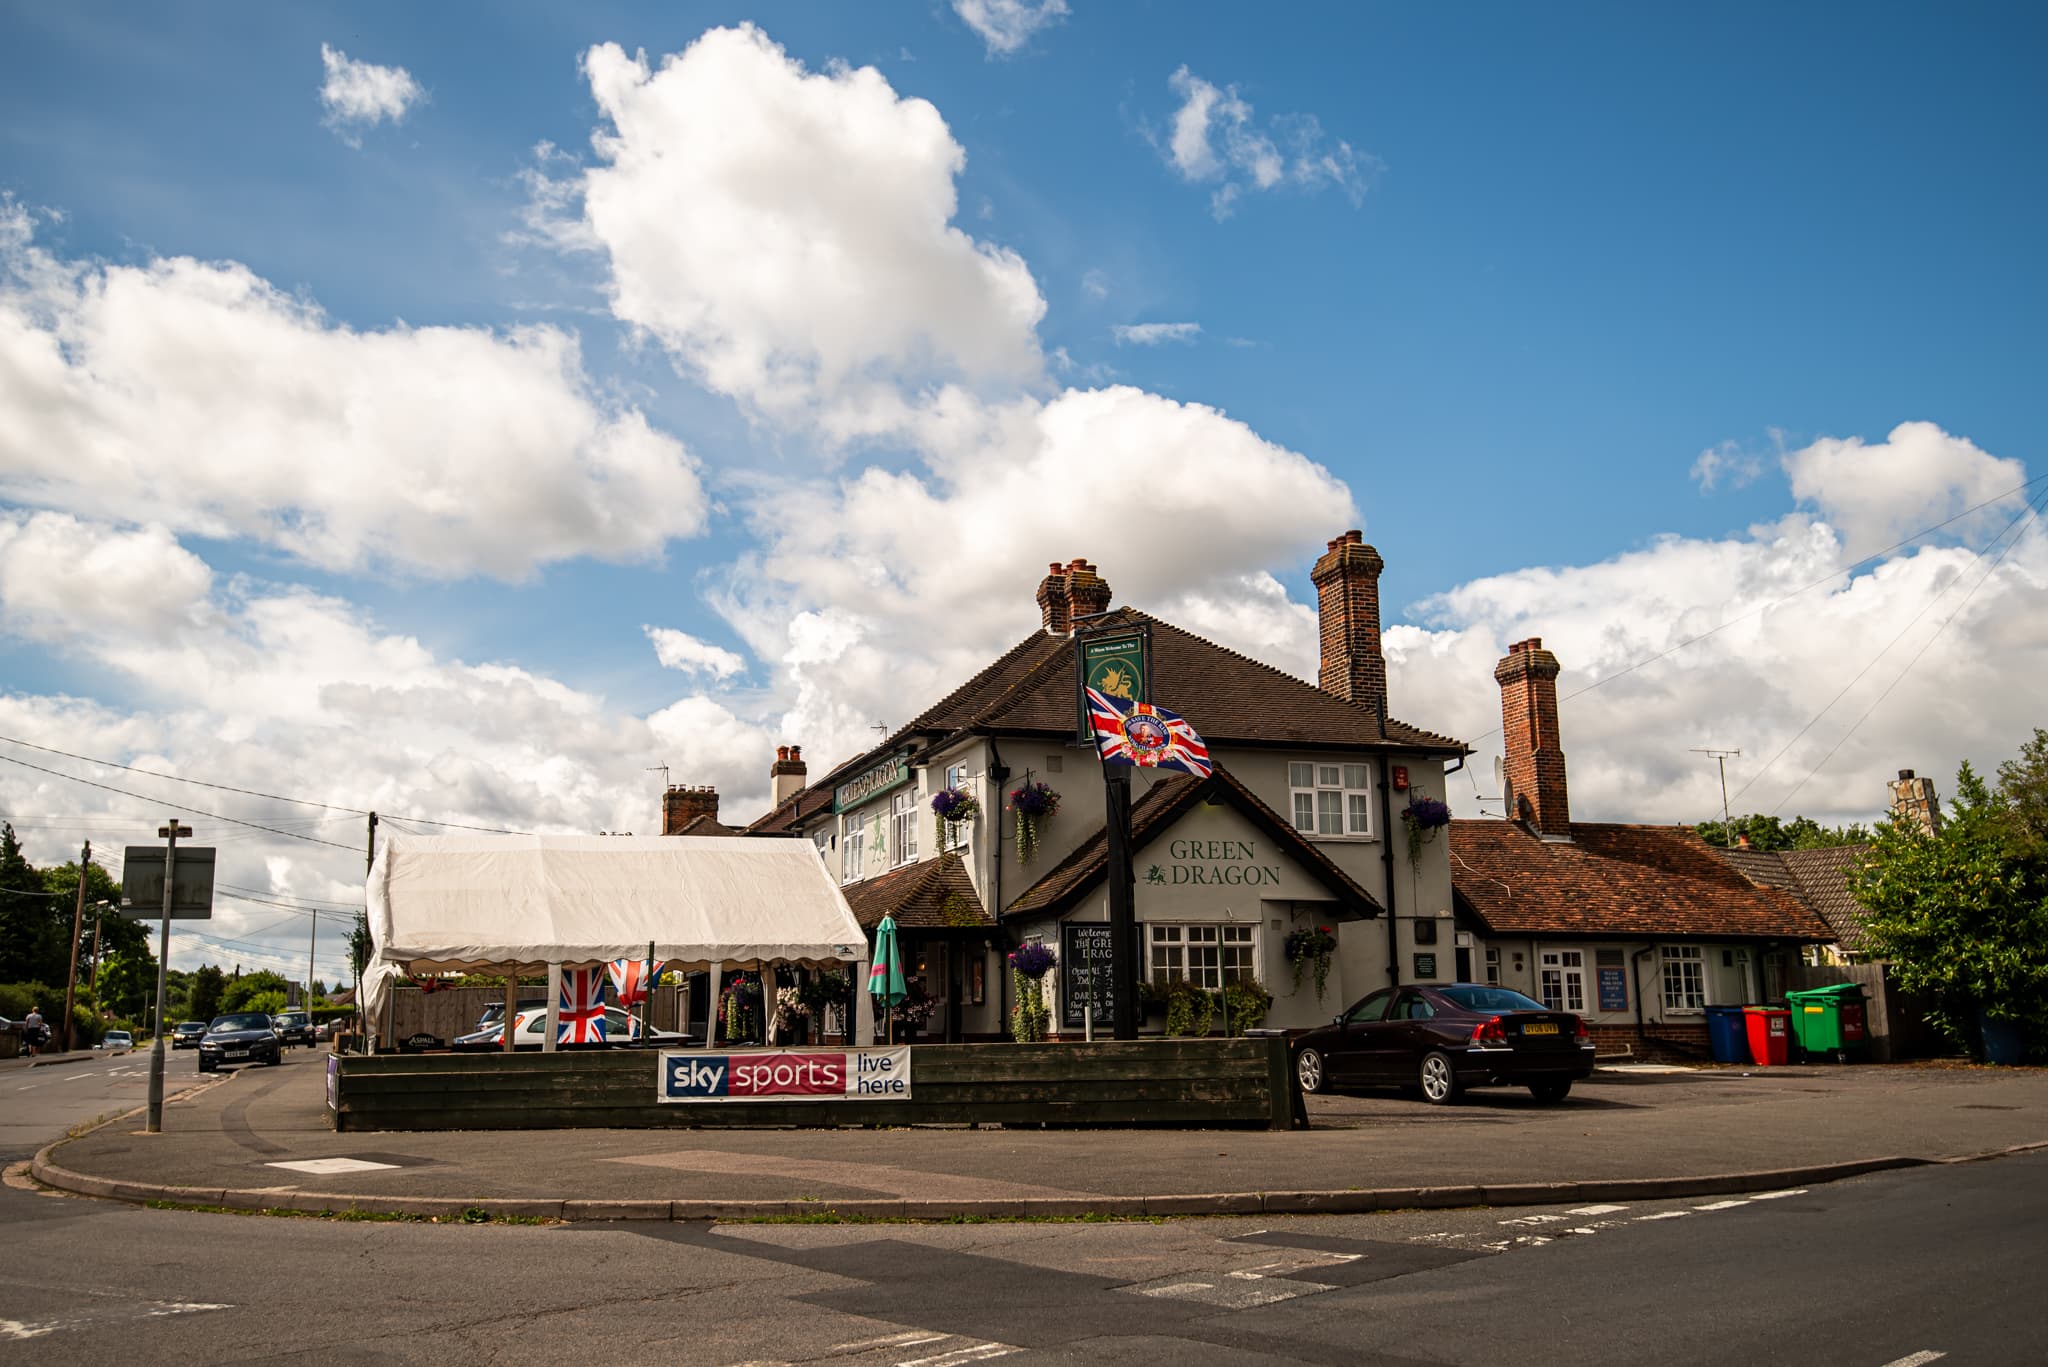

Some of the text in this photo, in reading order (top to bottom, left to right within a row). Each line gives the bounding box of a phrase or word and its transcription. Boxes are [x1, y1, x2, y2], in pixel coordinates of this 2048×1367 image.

[840, 778, 866, 807] GREEN
[1170, 839, 1255, 860] GREEN
[1172, 865, 1280, 886] DRAGON
[1074, 992, 1098, 1000] DARS
[409, 1036, 434, 1046] ASPALL
[857, 1052, 892, 1072] live
[674, 1059, 840, 1094] sky sports
[857, 1076, 904, 1094] here
